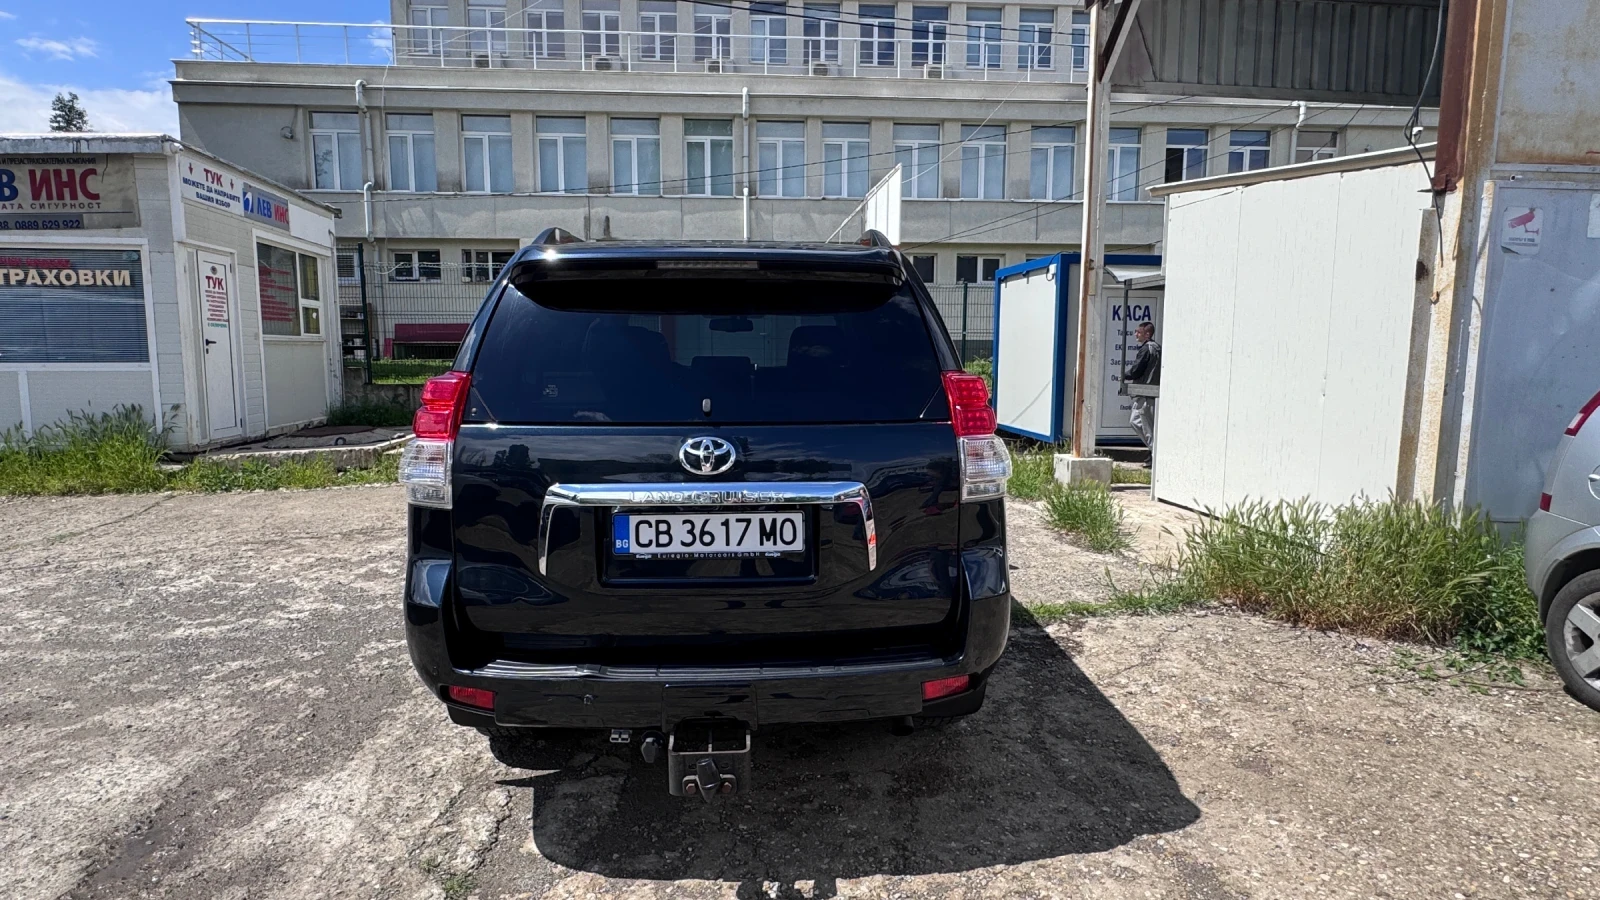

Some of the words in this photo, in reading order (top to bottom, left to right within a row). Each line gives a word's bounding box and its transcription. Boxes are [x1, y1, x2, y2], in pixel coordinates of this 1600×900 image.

[28, 168, 100, 201] ИНС
[203, 167, 223, 187] ТУК
[182, 176, 206, 191] МОЖЕТЕ
[206, 184, 214, 194] ДА
[213, 187, 240, 203] НАПРАВИТЕ
[30, 202, 102, 210] СИГУРНОСТ
[195, 191, 215, 203] ВАШИЯ
[215, 198, 231, 208] ИЗБОР
[257, 197, 272, 219] ЛЕВ
[273, 203, 289, 224] ИНС
[15, 220, 39, 230] 0889
[42, 220, 60, 230] 629
[62, 219, 81, 229] 922
[205, 275, 225, 291] ТУК
[628, 490, 683, 504] LAND
[691, 490, 785, 504] CRUISER
[634, 519, 673, 548] CB
[680, 517, 752, 547] 3617
[758, 517, 798, 547] MO
[615, 539, 629, 549] BG
